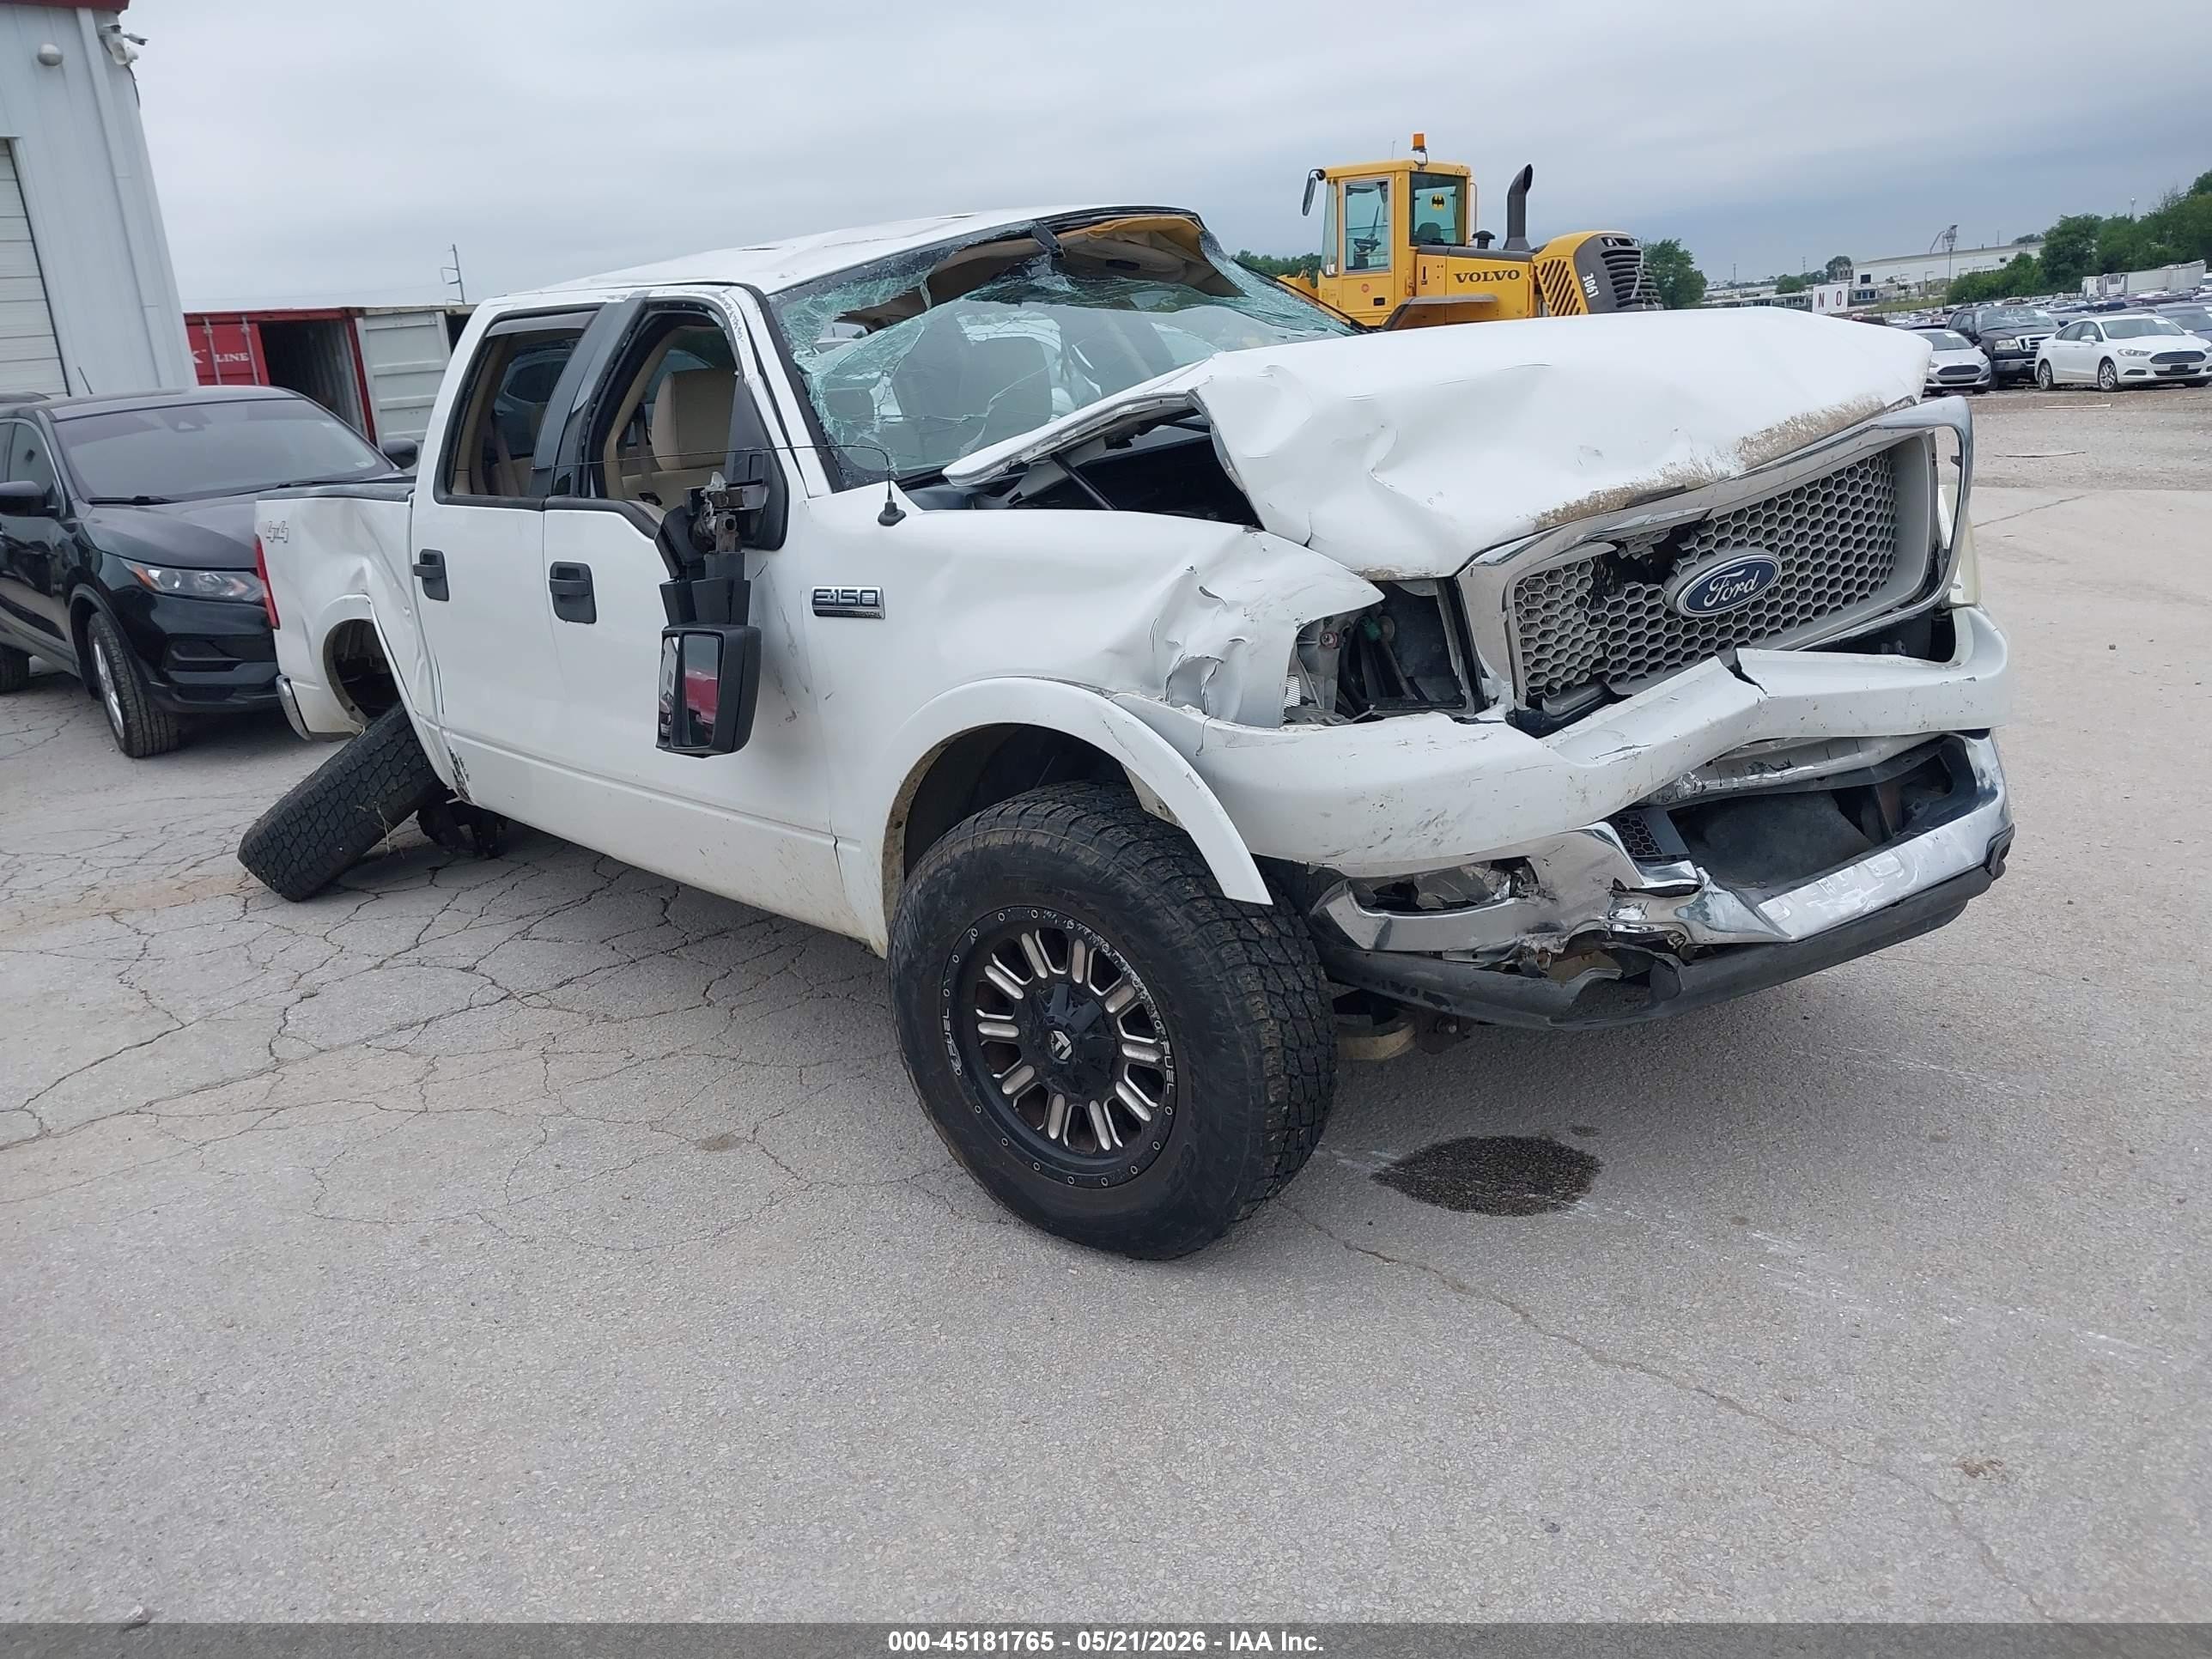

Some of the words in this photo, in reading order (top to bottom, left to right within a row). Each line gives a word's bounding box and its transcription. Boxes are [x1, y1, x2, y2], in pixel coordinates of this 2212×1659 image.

[1453, 270, 1520, 283] VOLVO
[1582, 272, 1599, 299] L90E
[215, 352, 249, 362] LINE
[1704, 568, 1759, 607] Ford
[1160, 1040, 1175, 1095] FUEL
